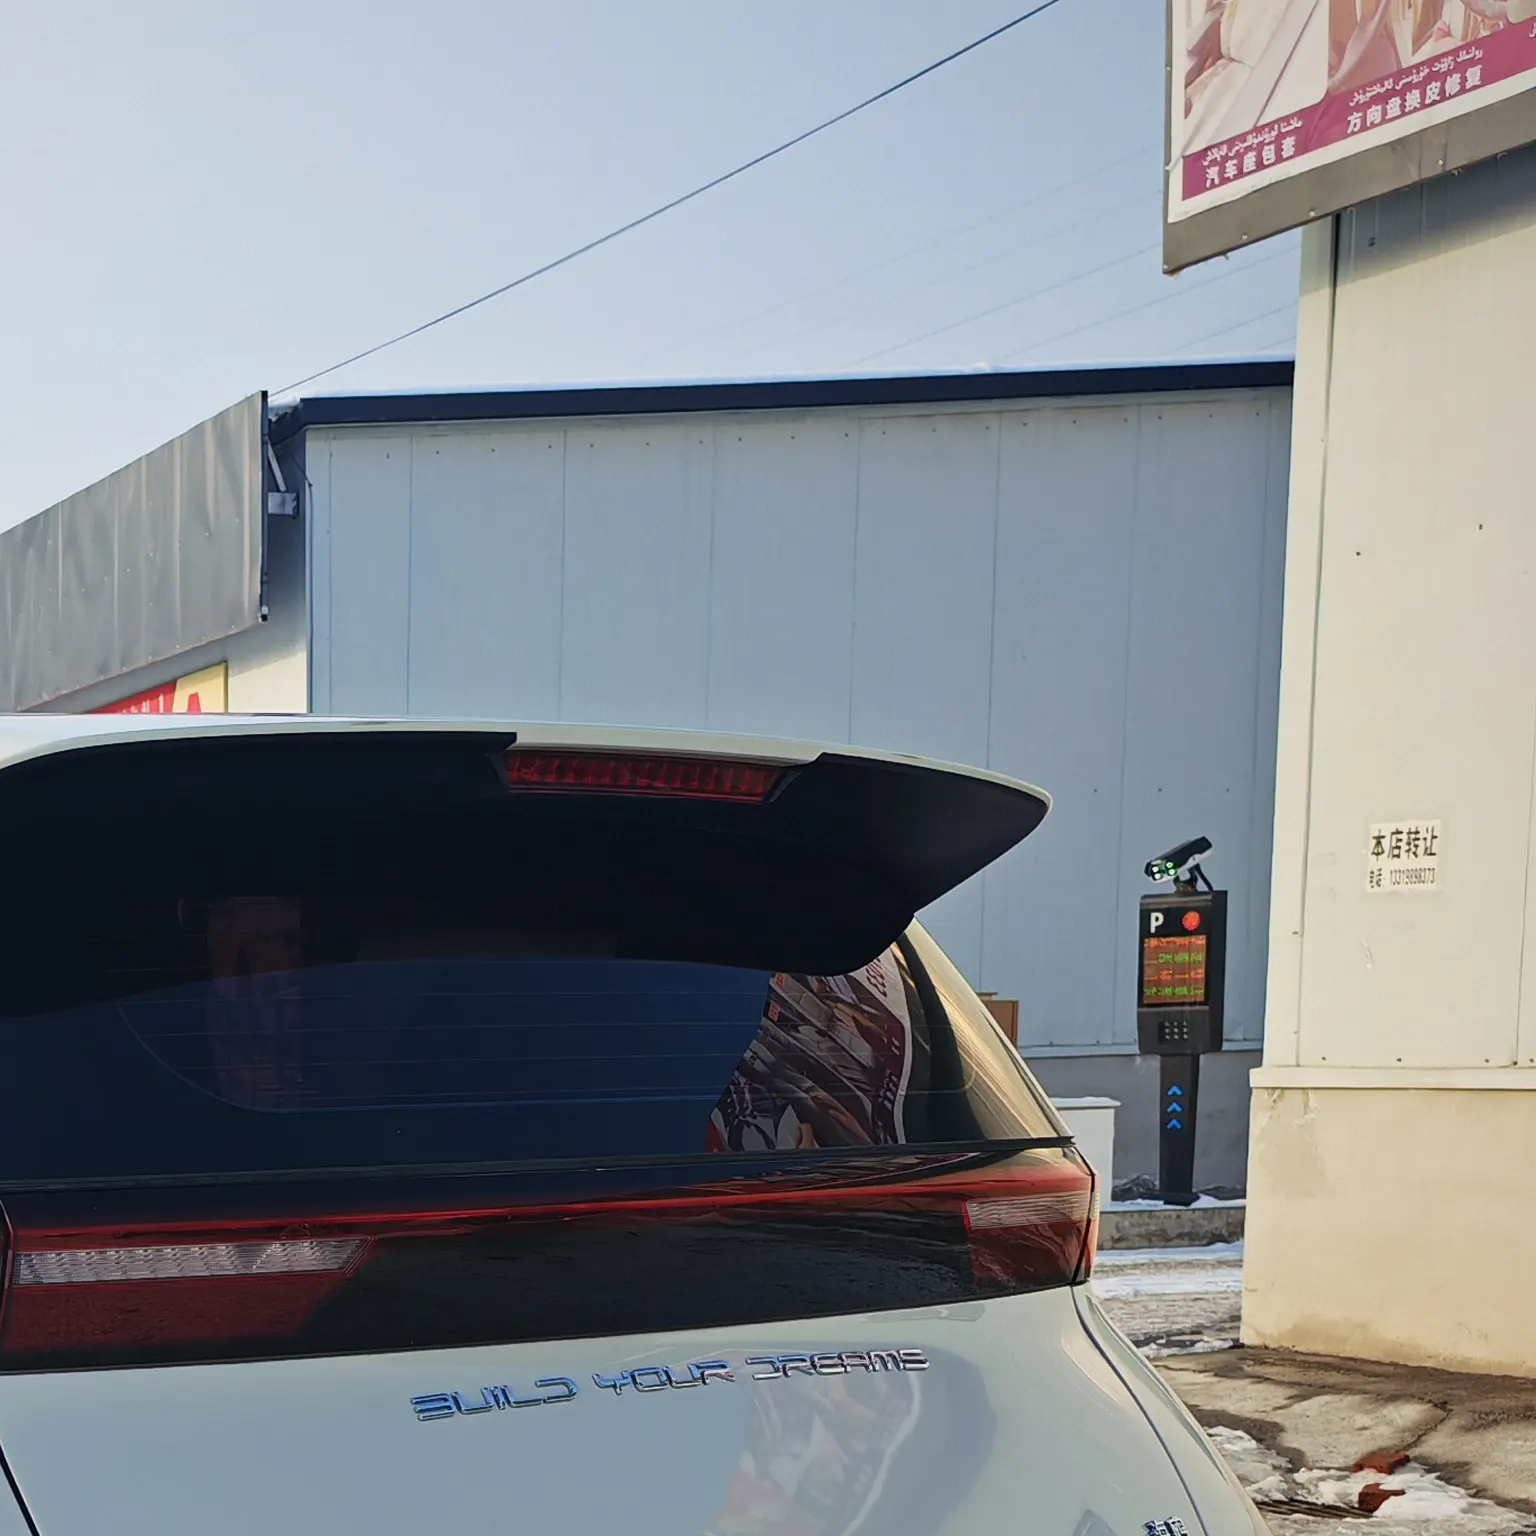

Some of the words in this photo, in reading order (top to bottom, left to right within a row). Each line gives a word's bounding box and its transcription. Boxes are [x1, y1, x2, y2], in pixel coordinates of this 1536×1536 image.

[1347, 64, 1483, 134] 方向盘换皮修复
[1371, 824, 1438, 862] 本店转让
[1150, 912, 1164, 934] P
[410, 1376, 580, 1421] BUILD
[592, 1359, 735, 1396] YOUR
[745, 1348, 930, 1381] DREAMS
